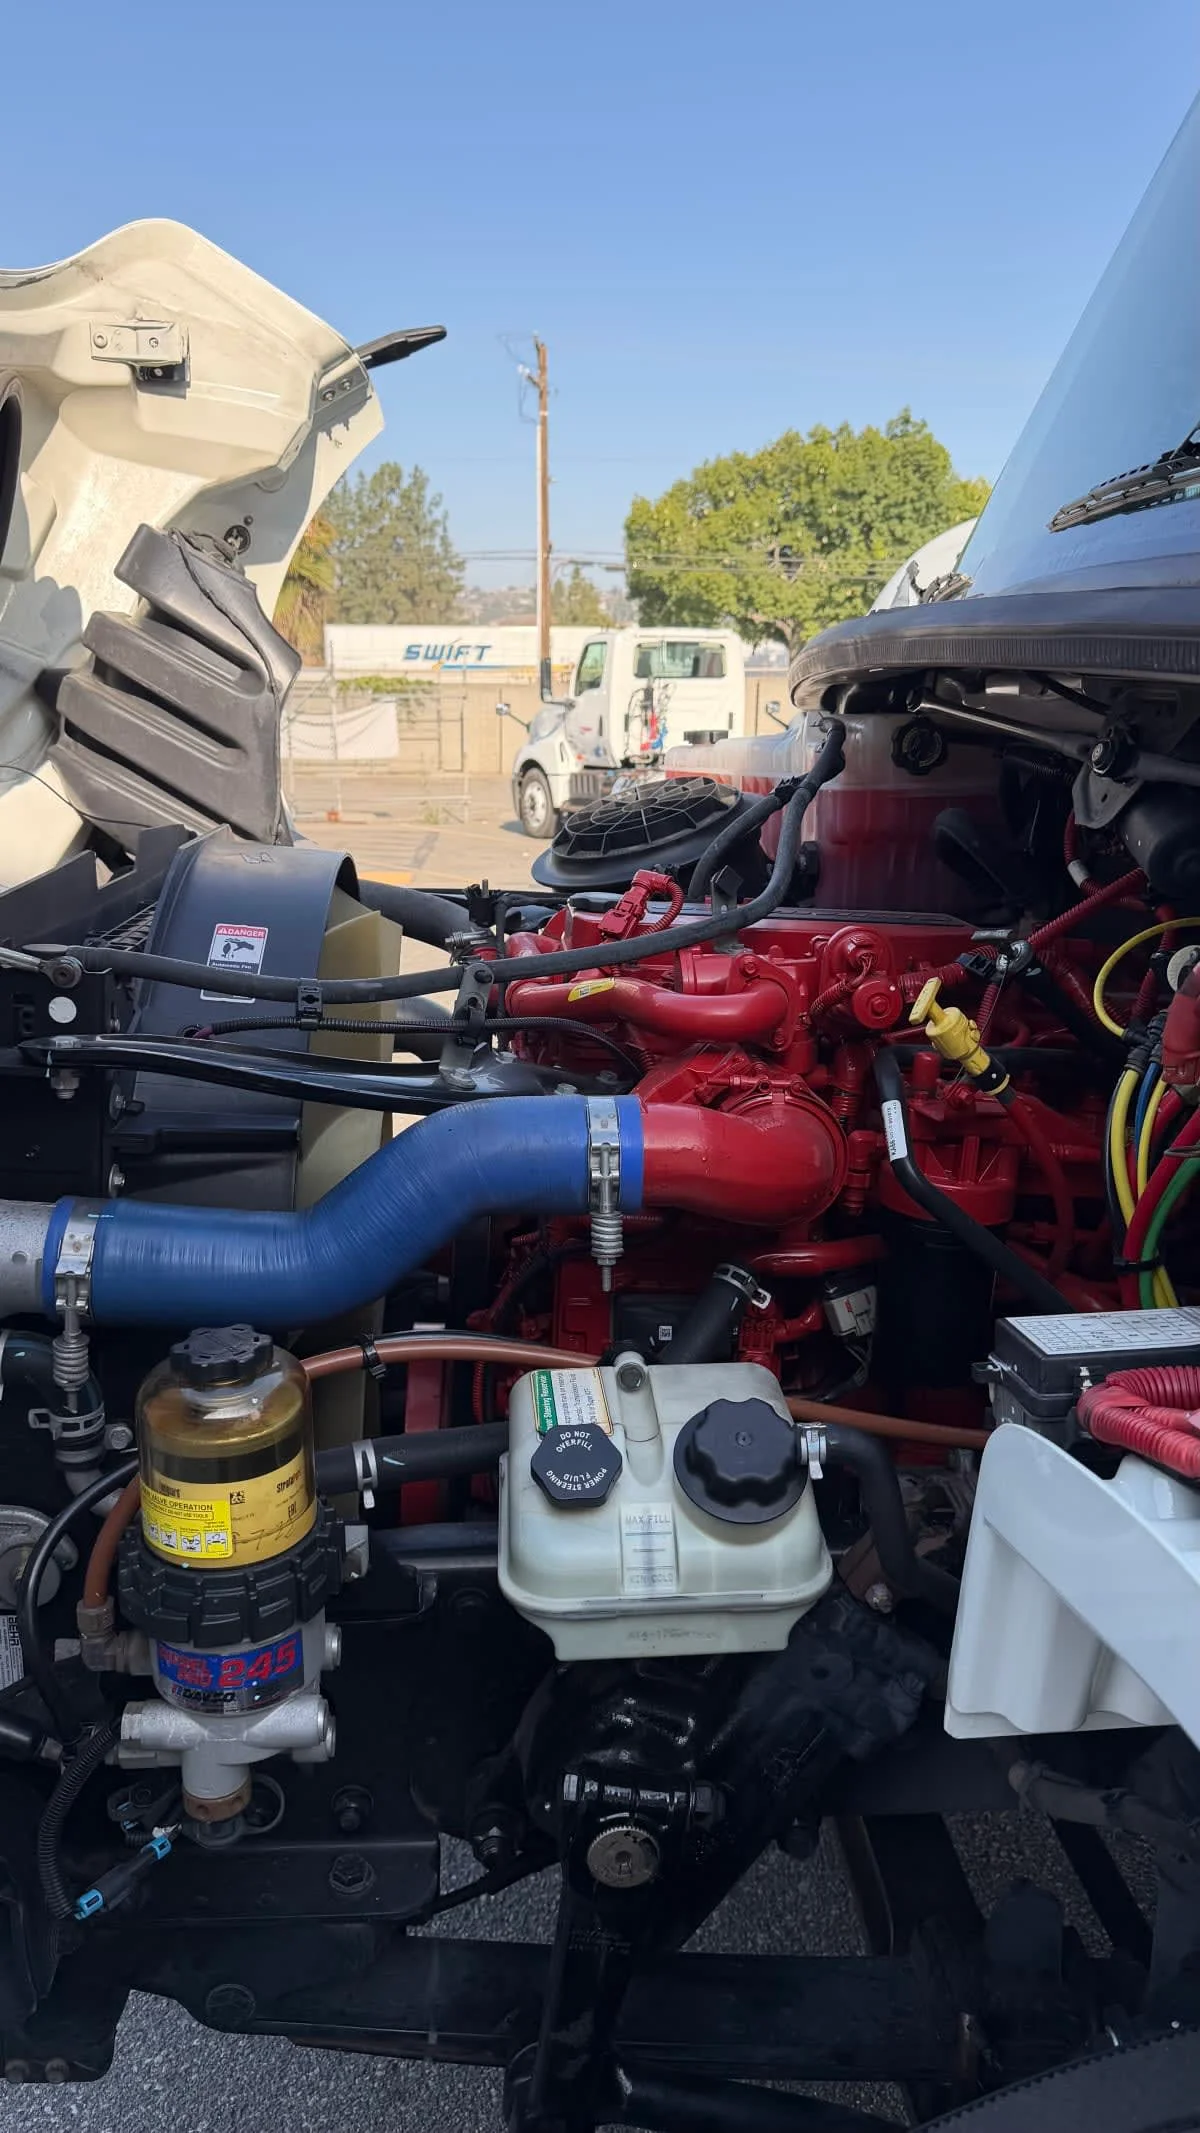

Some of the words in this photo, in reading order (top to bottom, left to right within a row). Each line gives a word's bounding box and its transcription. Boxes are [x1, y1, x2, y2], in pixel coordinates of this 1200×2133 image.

[402, 643, 492, 661] SWIFT
[227, 928, 265, 938] DANGER
[543, 1397, 553, 1419] Steering
[560, 1432, 571, 1440] DO
[574, 1430, 591, 1439] NOT
[556, 1438, 593, 1453] OVERFILL
[546, 1470, 582, 1491] STEERING
[563, 1472, 591, 1482] FLUID
[584, 1467, 608, 1489] POWER
[168, 1501, 213, 1511] OPERATION
[625, 1514, 644, 1525] MAX
[647, 1513, 671, 1525] FILL
[8, 1616, 20, 1647] BEHR
[218, 1639, 297, 1688] 245
